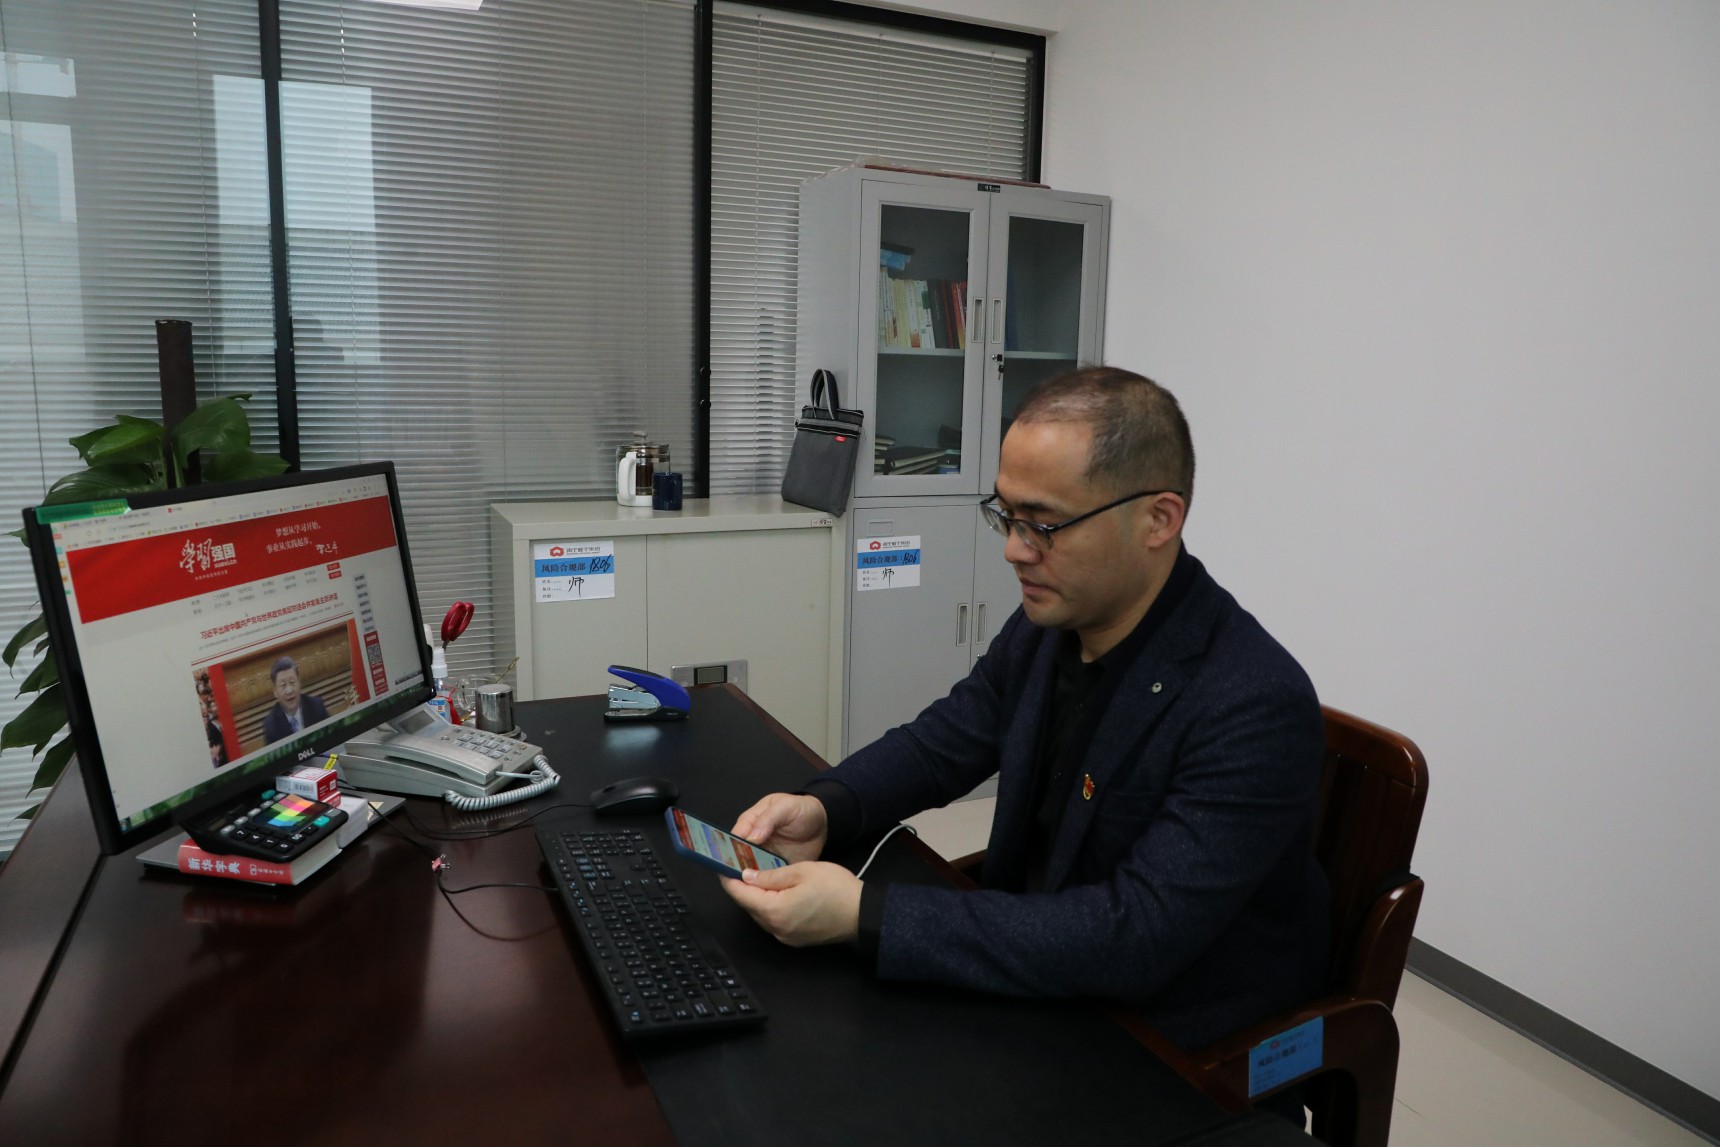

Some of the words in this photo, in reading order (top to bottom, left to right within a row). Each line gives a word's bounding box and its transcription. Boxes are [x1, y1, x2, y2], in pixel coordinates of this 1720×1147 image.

[297, 747, 316, 761] DELL
[188, 857, 240, 875] 新华字典
